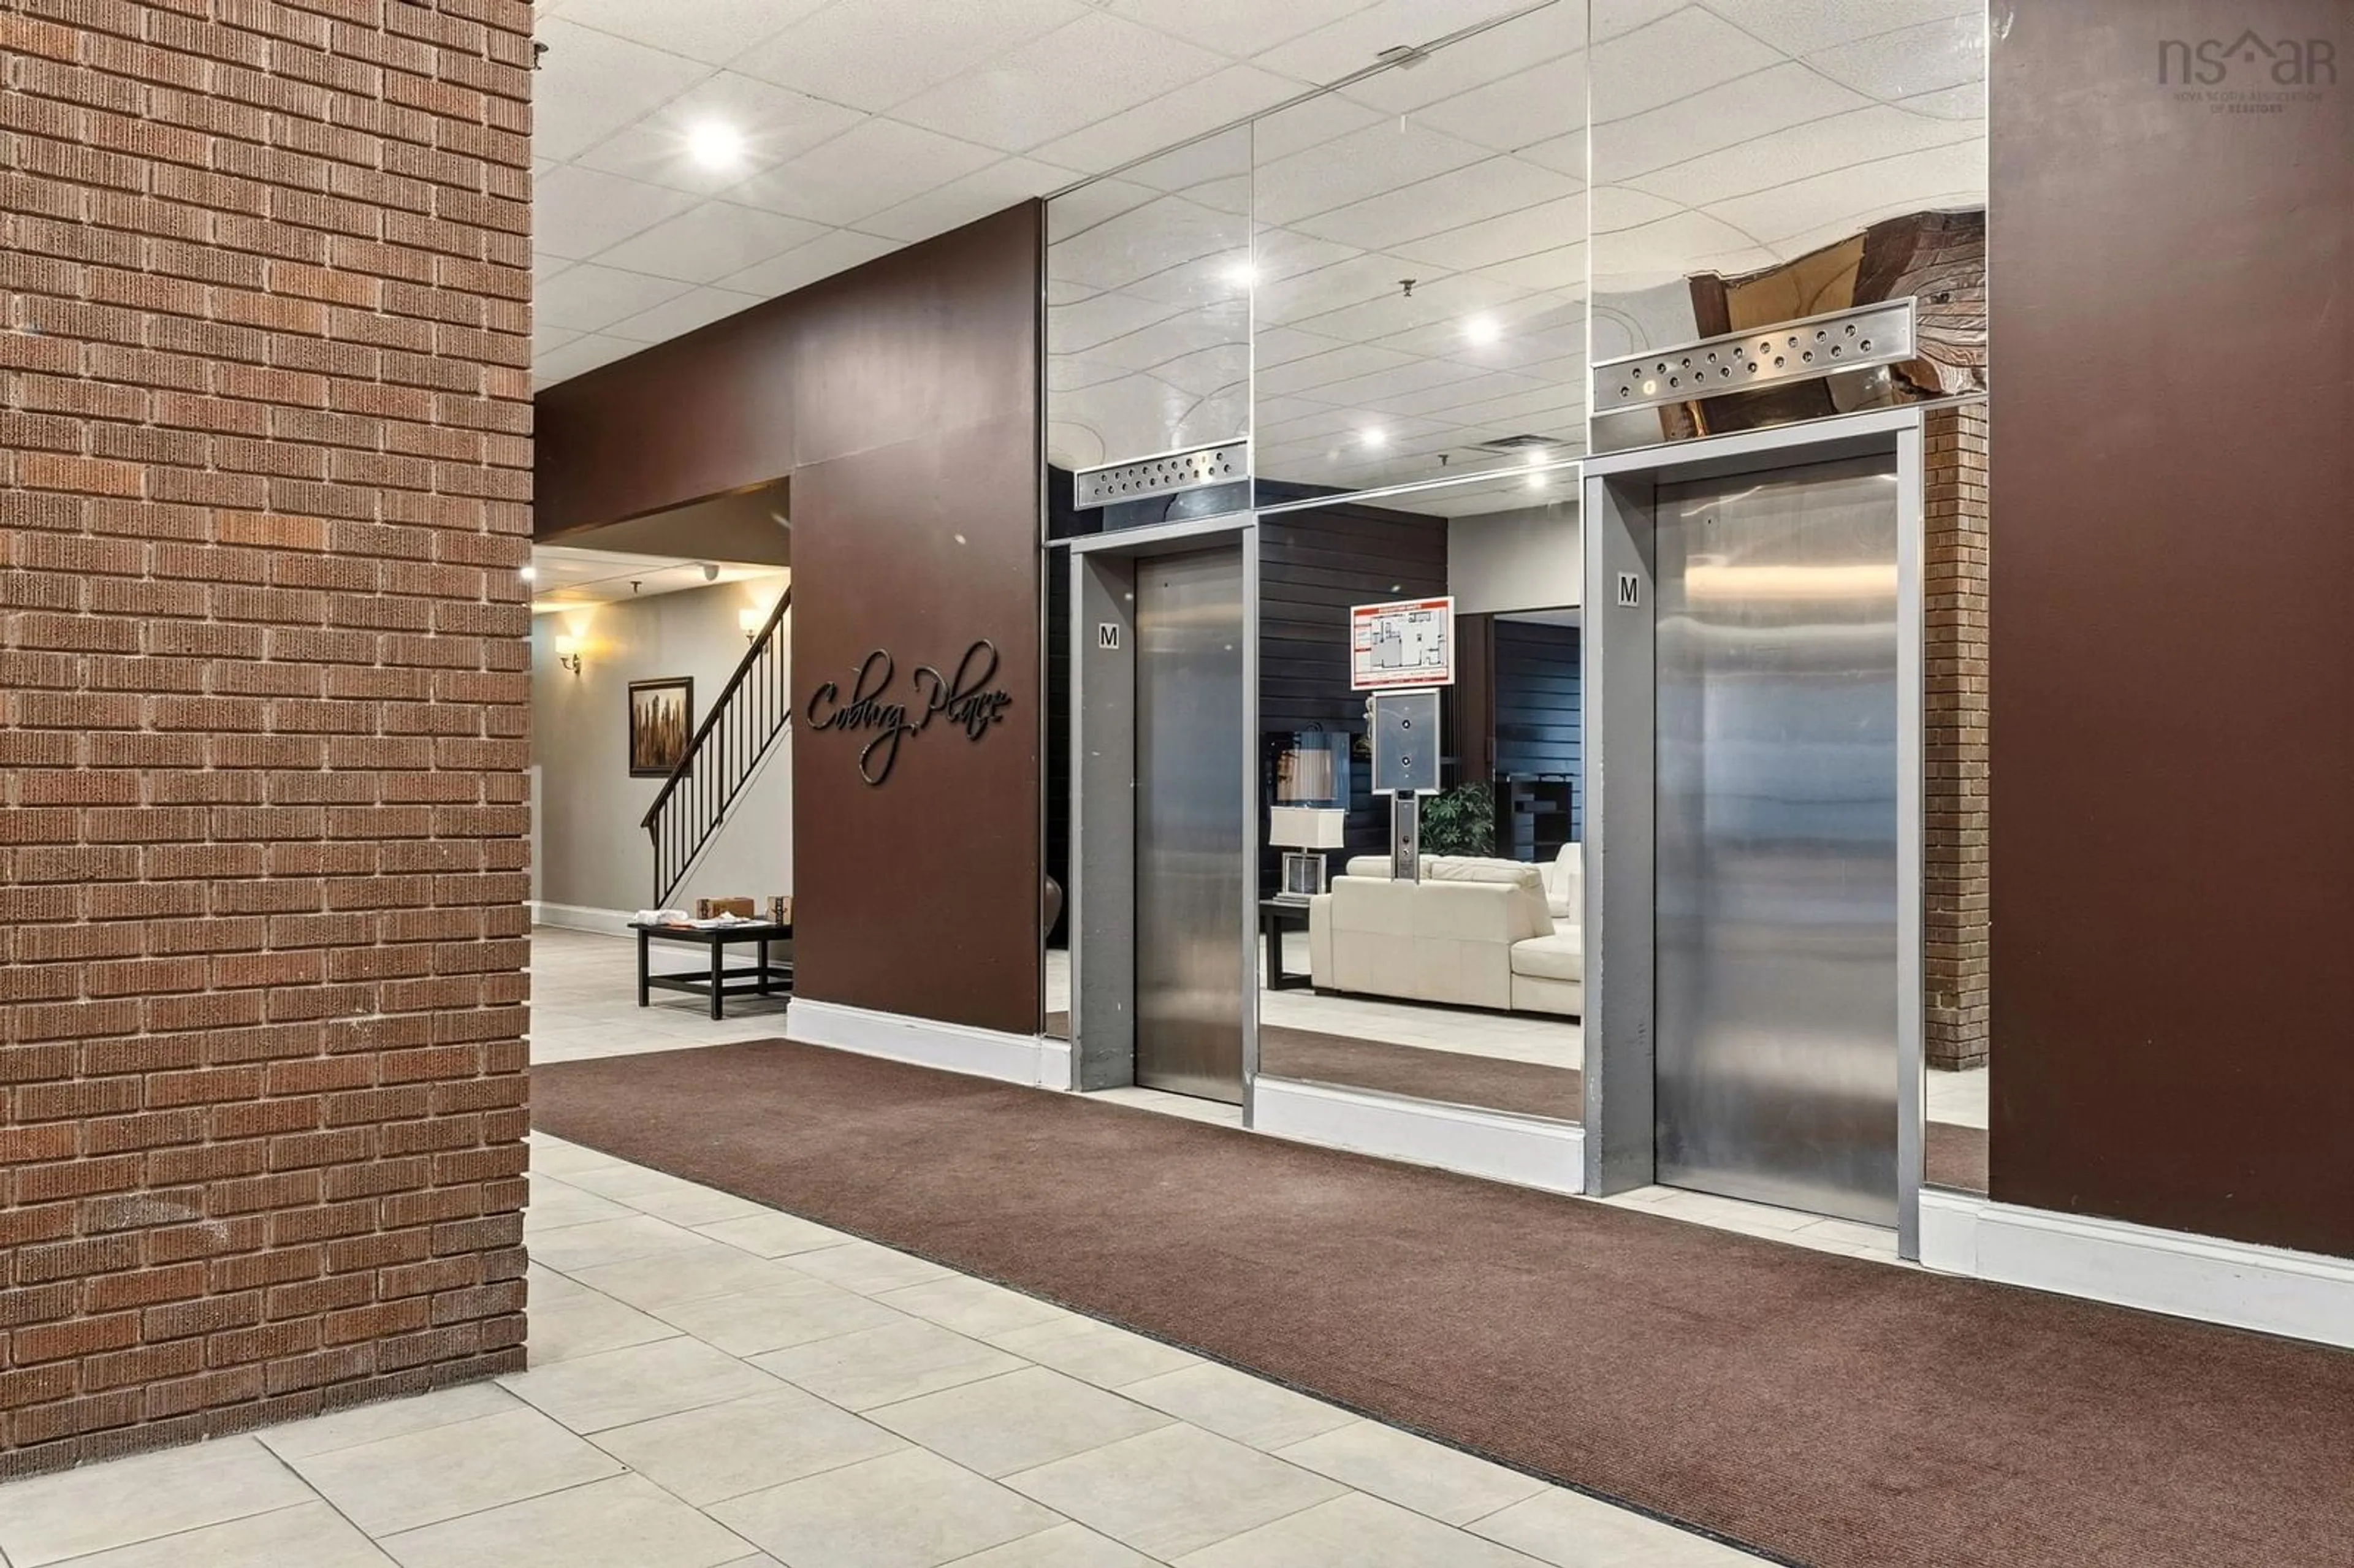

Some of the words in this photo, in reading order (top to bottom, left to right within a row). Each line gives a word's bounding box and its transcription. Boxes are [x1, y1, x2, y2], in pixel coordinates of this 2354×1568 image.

[1621, 576, 1637, 603] M
[1101, 625, 1117, 646] M
[913, 638, 1012, 741] Place
